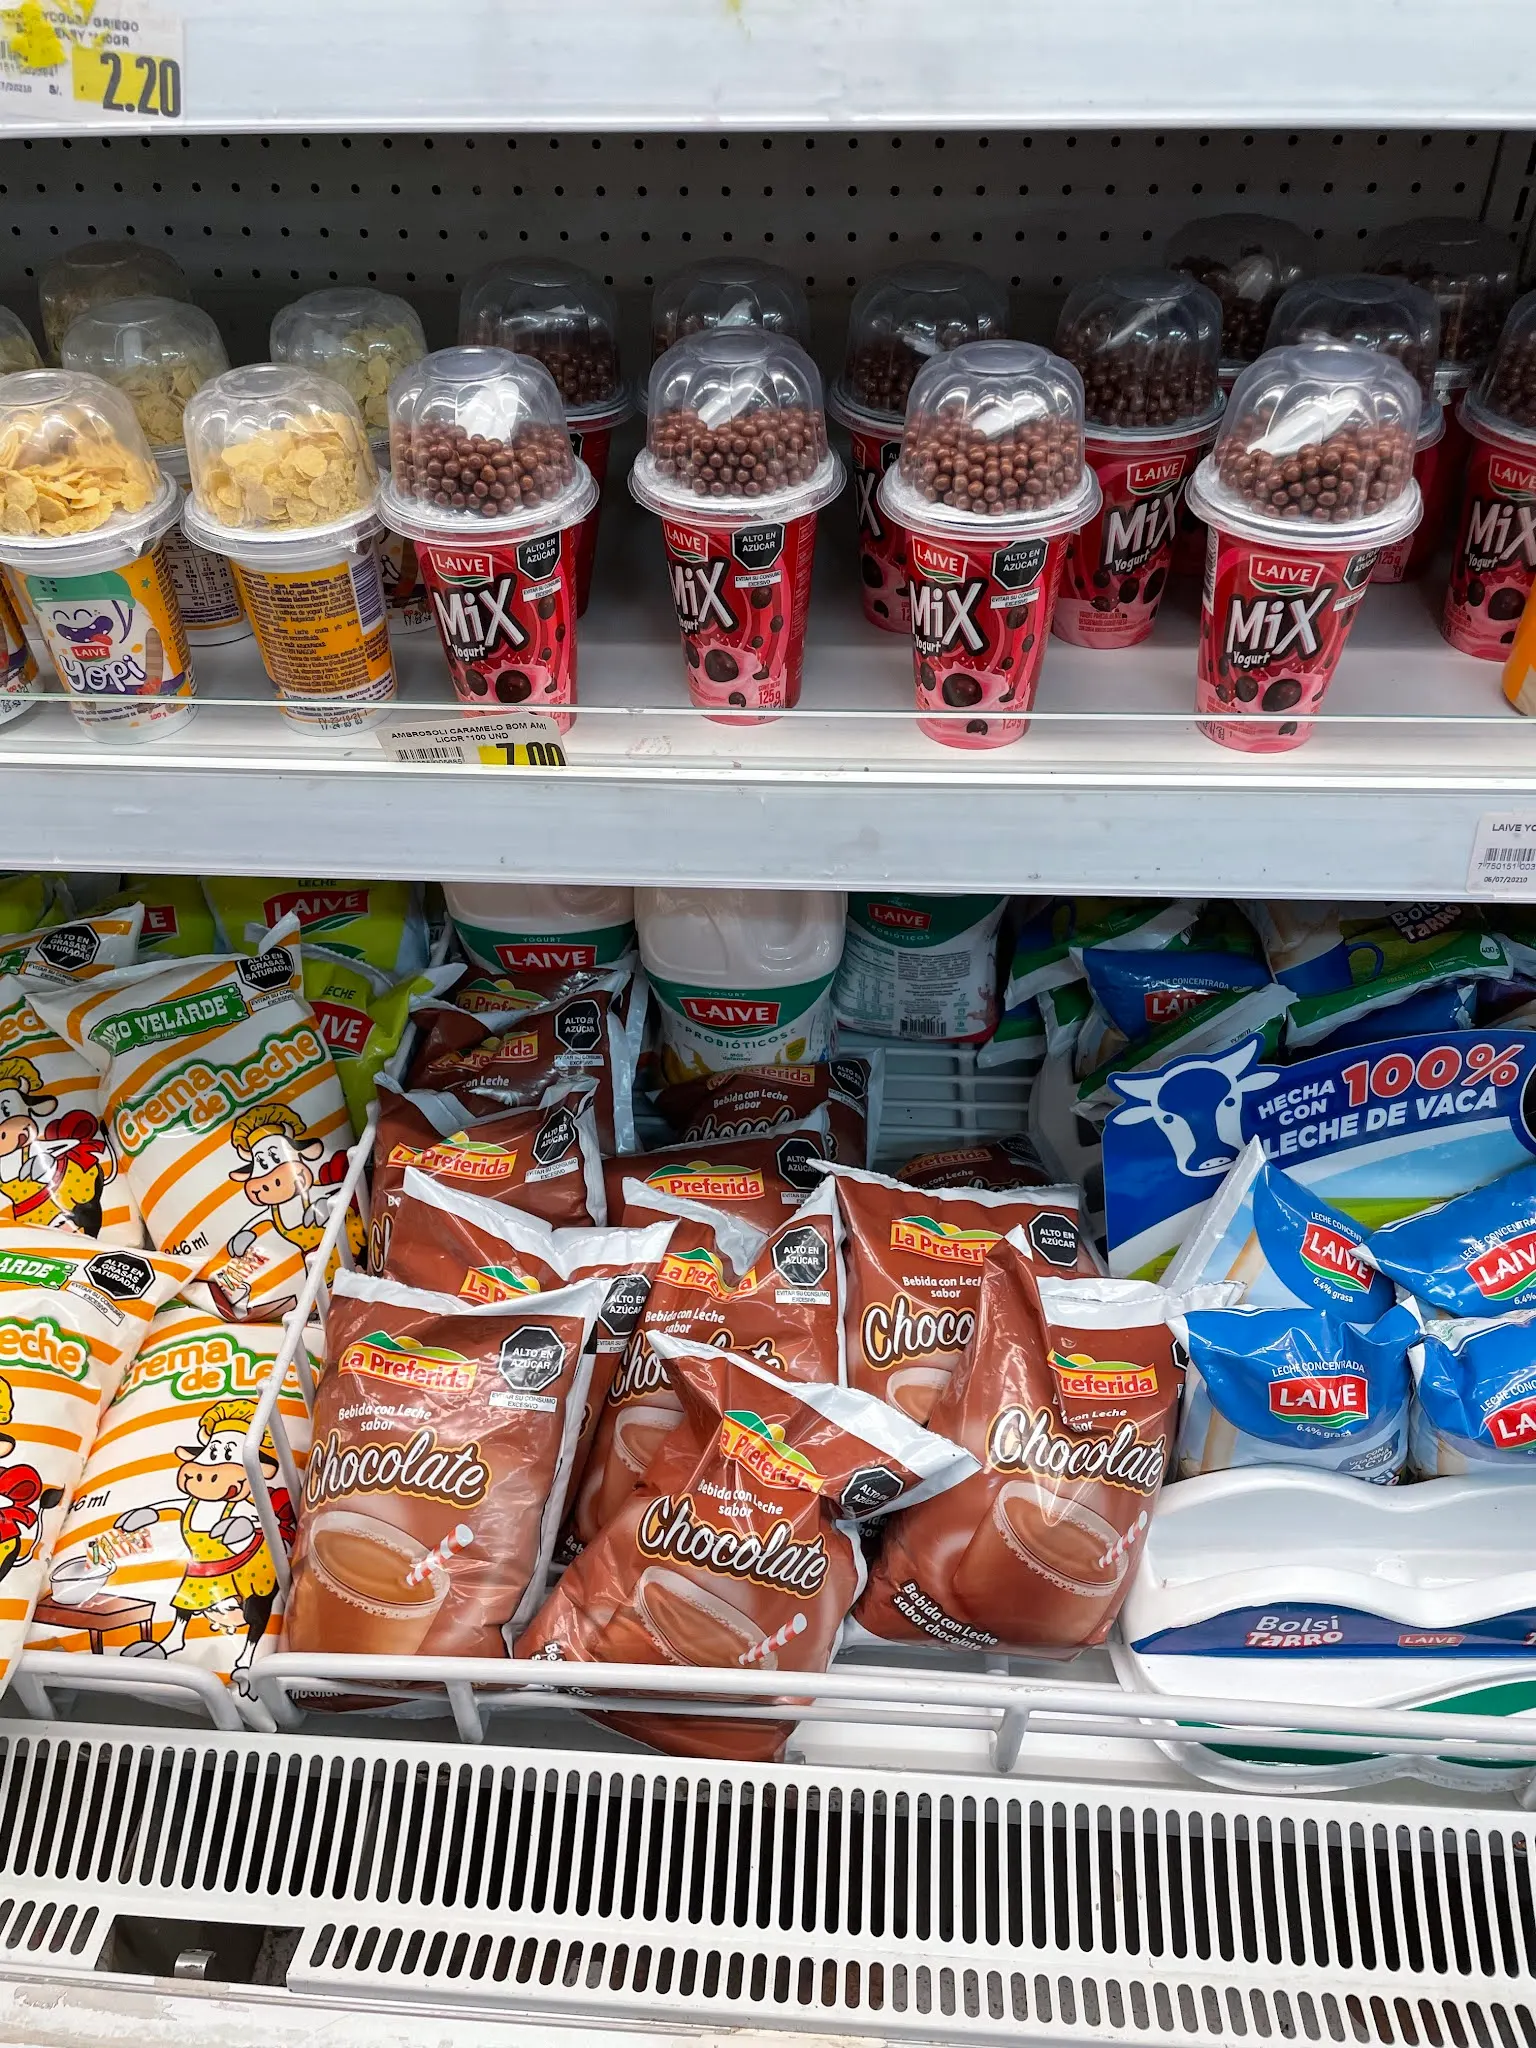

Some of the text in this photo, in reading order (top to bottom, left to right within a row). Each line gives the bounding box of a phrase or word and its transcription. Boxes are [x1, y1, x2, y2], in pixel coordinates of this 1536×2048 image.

[94, 18, 139, 32] GRIEGO
[100, 52, 181, 118] 2.20
[1135, 463, 1179, 482] LAIVE
[526, 538, 556, 554] ALTO EN
[667, 525, 702, 551] LAIVE
[742, 532, 776, 543] ALTO EN
[743, 540, 775, 552] AZÚCAR
[436, 553, 484, 573] LAIVE
[527, 547, 556, 564] AZÚCAR
[917, 545, 958, 572] LAIVE
[1003, 557, 1038, 572] AZÚCAR
[1004, 549, 1040, 562] ALTO EN
[1115, 549, 1151, 572] Yogurt
[1468, 553, 1498, 571] Yogurt
[1256, 561, 1312, 583] LAIVE
[74, 648, 107, 657] LAIVE
[452, 643, 485, 662] Yogurt
[915, 635, 941, 653] Yogurt
[1232, 651, 1271, 668] Yogurt
[391, 721, 527, 739] AMBROSOLI CARAMELO BOM
[435, 733, 464, 743] LICOR
[489, 732, 509, 740] UND
[1491, 823, 1522, 832] LAIVE
[274, 892, 361, 920] LAIVE
[874, 907, 925, 926] LAIVE
[50, 938, 87, 952] GRASAS
[77, 936, 89, 944] EN
[248, 952, 283, 965] ALTO EN
[250, 959, 285, 972] GRASAS
[506, 950, 588, 969] LAIVE
[323, 985, 356, 999] LECHE
[1172, 977, 1229, 989] CONCENTRADA
[134, 995, 226, 1034] VELARDE
[690, 1001, 769, 1022] LAIVE
[565, 1017, 586, 1025] ALTO
[565, 1023, 595, 1034] AZÚCAR
[685, 1026, 788, 1050] PROBIÓTICOS
[836, 1064, 854, 1076] ALTO
[118, 1029, 320, 1149] Crema de Leche
[480, 1075, 510, 1087] Leche
[1279, 1043, 1526, 1127] CON 100%
[713, 1089, 789, 1108] Bebida con Leche
[734, 1101, 761, 1112] sabor
[1258, 1079, 1336, 1120] HECHA
[1264, 1086, 1498, 1158] LECHE DE VACA
[420, 1150, 511, 1176] Preferida
[786, 1155, 806, 1163] ALTO
[946, 1169, 974, 1180] Leche
[670, 1178, 761, 1196] Preferida
[1310, 1211, 1332, 1227] LECHE
[192, 1231, 210, 1252] ml
[894, 1228, 917, 1247] La
[1039, 1227, 1075, 1240] ALTO EN
[1041, 1235, 1076, 1248] AZÚCAR
[783, 1245, 820, 1255] ALTO EN
[1309, 1231, 1370, 1280] LAIVE
[1460, 1239, 1485, 1261] LECHE
[104, 1258, 145, 1278] ALTO EN
[785, 1253, 819, 1266] AZÚCAR
[90, 1265, 142, 1294] SATURADAS
[101, 1263, 139, 1284] GRASAS
[657, 1263, 679, 1281] La
[71, 1282, 92, 1295] EVITAR
[92, 1290, 101, 1300] SU
[466, 1276, 490, 1299] La
[902, 1276, 958, 1288] Bebida con
[1313, 1277, 1354, 1303] 6.4% grasa
[608, 1294, 634, 1304] ALTO
[930, 1288, 961, 1299] sabor
[83, 1293, 109, 1314] EXCESIVO
[645, 1307, 725, 1324] Bebida con Leche
[664, 1321, 691, 1334] sabor
[512, 1347, 555, 1360] ALTO EN
[340, 1350, 471, 1389] La Preferida
[510, 1356, 551, 1371] AZÚCAR
[1272, 1362, 1302, 1378] LECHE
[180, 1362, 222, 1391] de
[1279, 1384, 1358, 1411] LAIVE
[1480, 1389, 1511, 1412] LECHE
[338, 1401, 433, 1421] Bebida con Leche
[1069, 1408, 1128, 1423] con Leche
[360, 1418, 395, 1433] sabor
[1296, 1423, 1352, 1440] 6.4% grasa
[993, 1409, 1165, 1488] Chocolate
[1366, 1446, 1384, 1459] CON
[306, 1430, 485, 1504] Chocolate
[733, 1432, 820, 1494] Preferida
[86, 1489, 108, 1510] ml
[697, 1478, 784, 1515] Bebida con Leche
[860, 1484, 881, 1500] ALTO
[718, 1503, 753, 1518] sabor
[643, 1495, 827, 1590] Chocolate
[893, 1595, 983, 1651] sabor chocolate
[903, 1582, 999, 1646] Bebida con Leche
[1256, 1614, 1340, 1634] Bolsi
[1404, 1636, 1458, 1644] LAIVE
